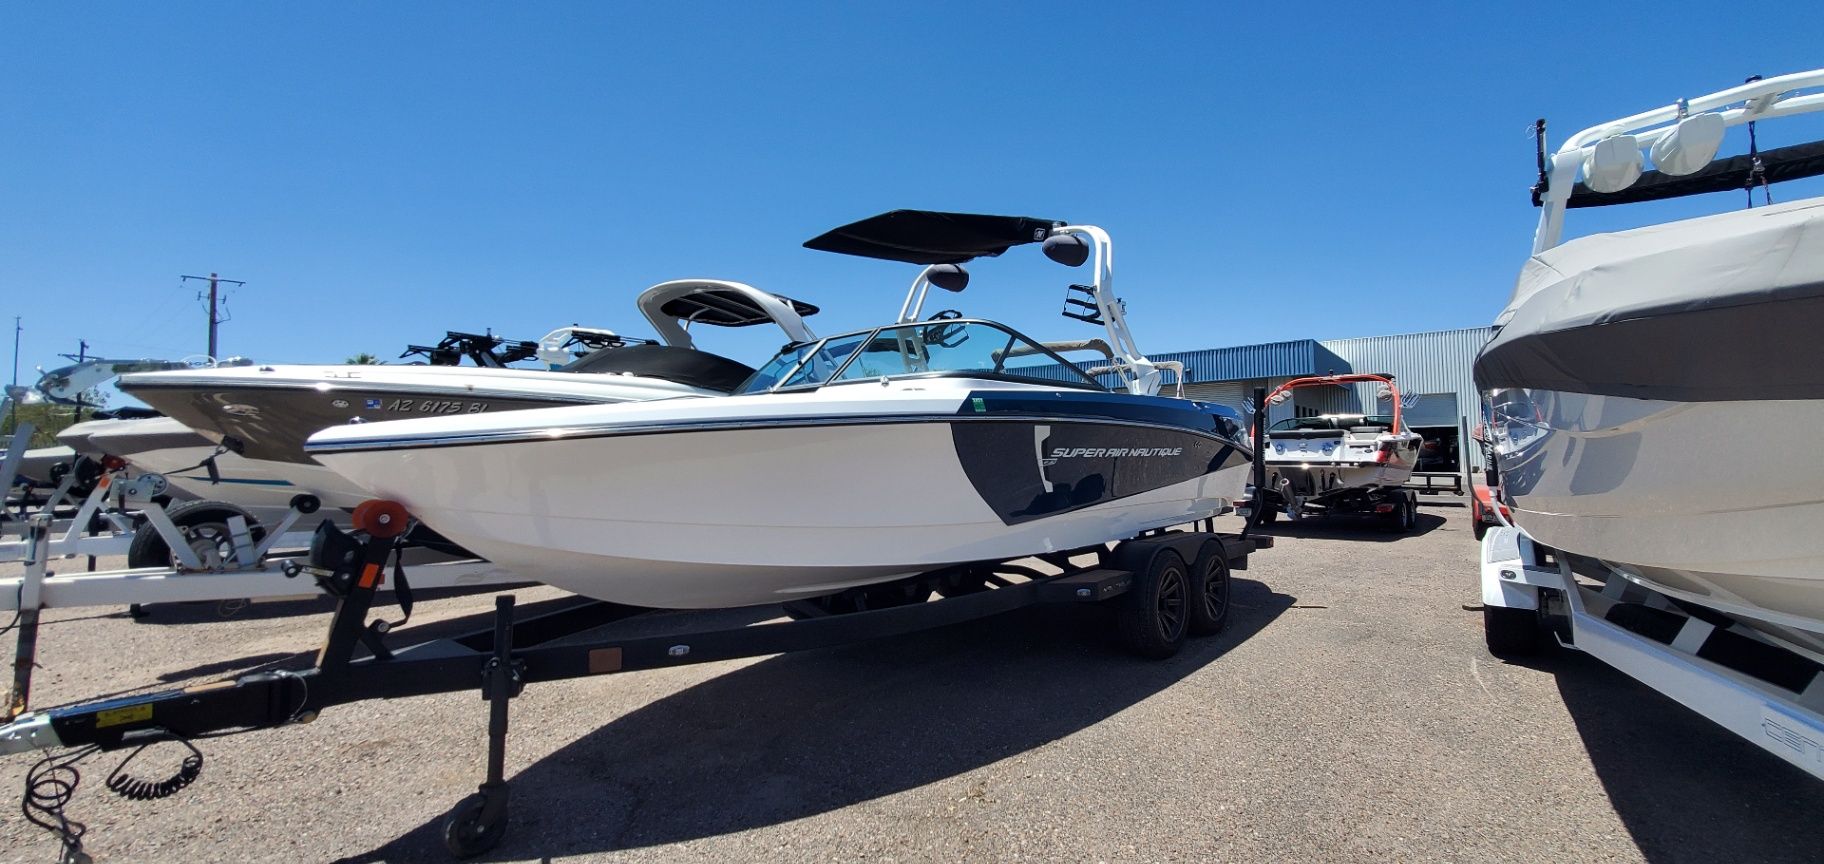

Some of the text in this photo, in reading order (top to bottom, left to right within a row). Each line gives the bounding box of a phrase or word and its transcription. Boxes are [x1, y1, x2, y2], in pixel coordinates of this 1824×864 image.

[388, 399, 413, 411] AZ
[419, 400, 463, 413] 6175
[1051, 447, 1183, 458] SUPER AIR NAUTIQUE
